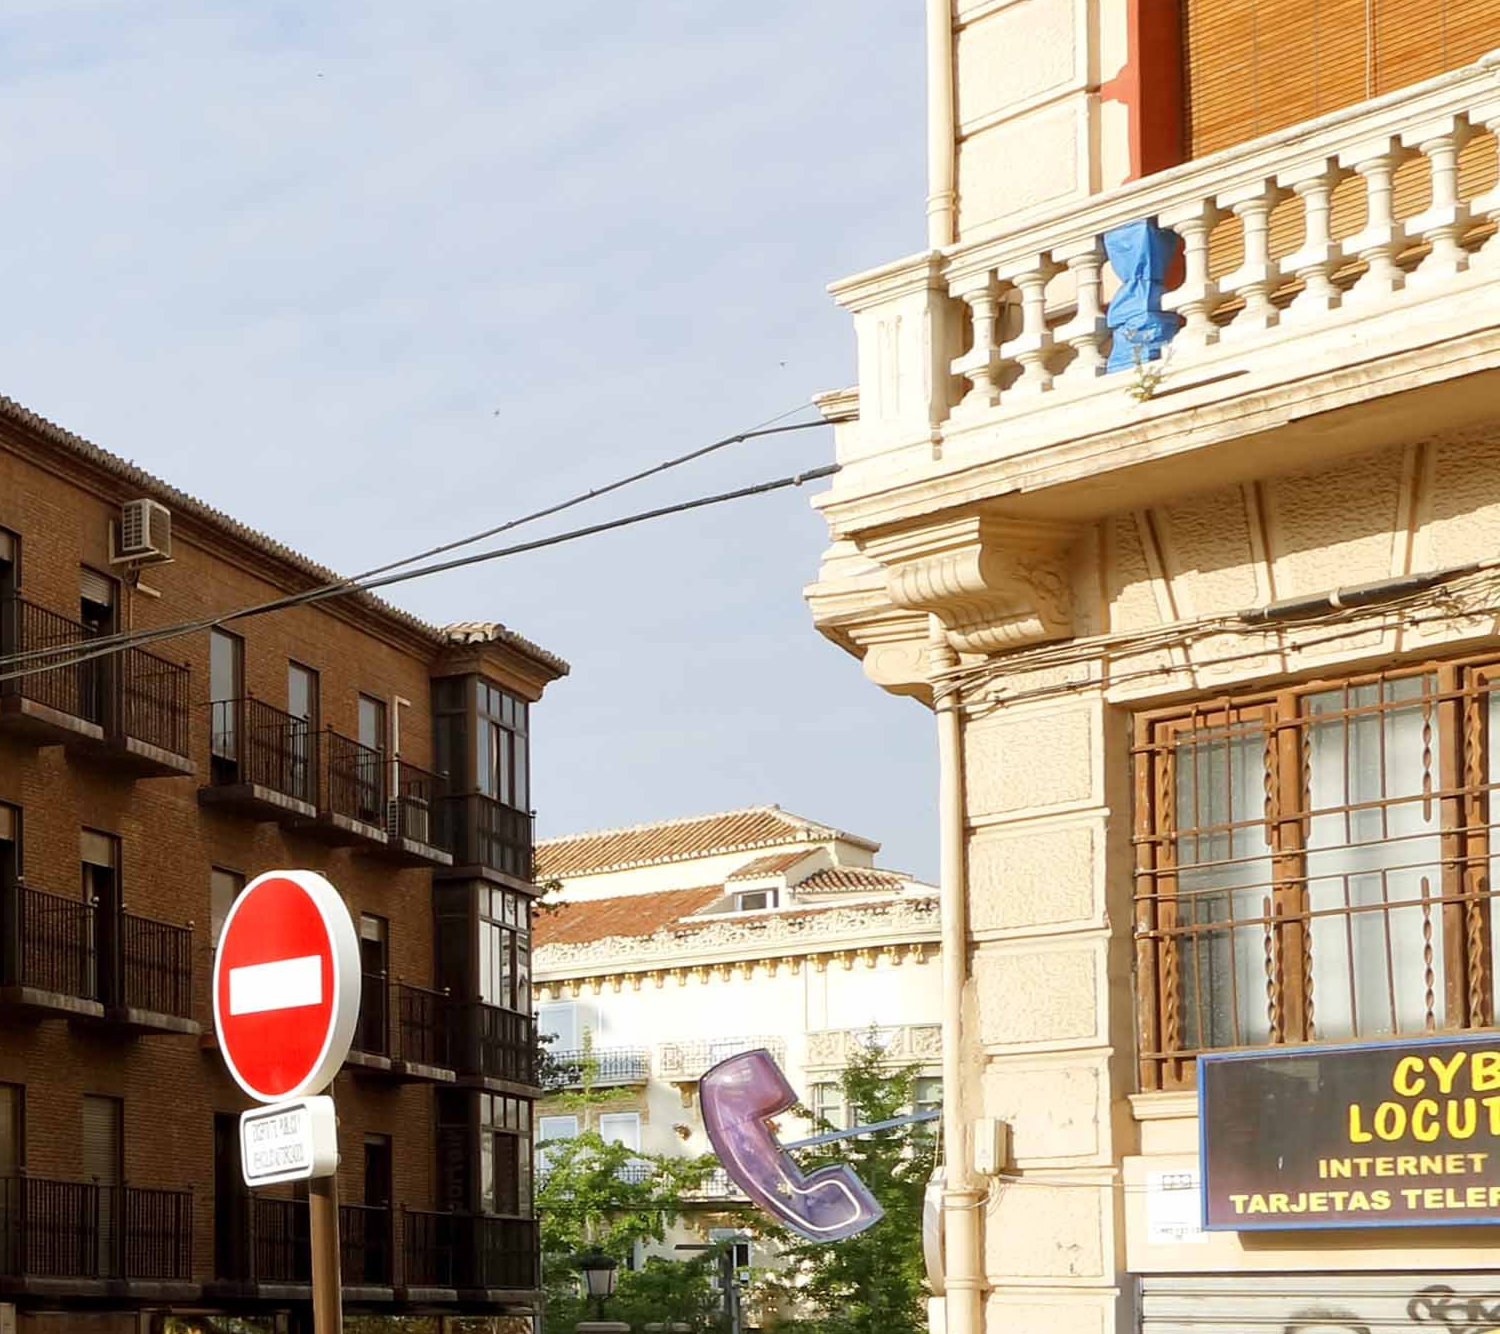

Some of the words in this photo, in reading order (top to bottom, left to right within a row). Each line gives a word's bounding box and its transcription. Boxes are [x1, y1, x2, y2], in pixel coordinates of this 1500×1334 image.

[1392, 1051, 1500, 1097] CYB
[1349, 1096, 1500, 1143] LOCUT
[1318, 1153, 1489, 1179] INTERNET
[1228, 1190, 1392, 1214] TARJETAS
